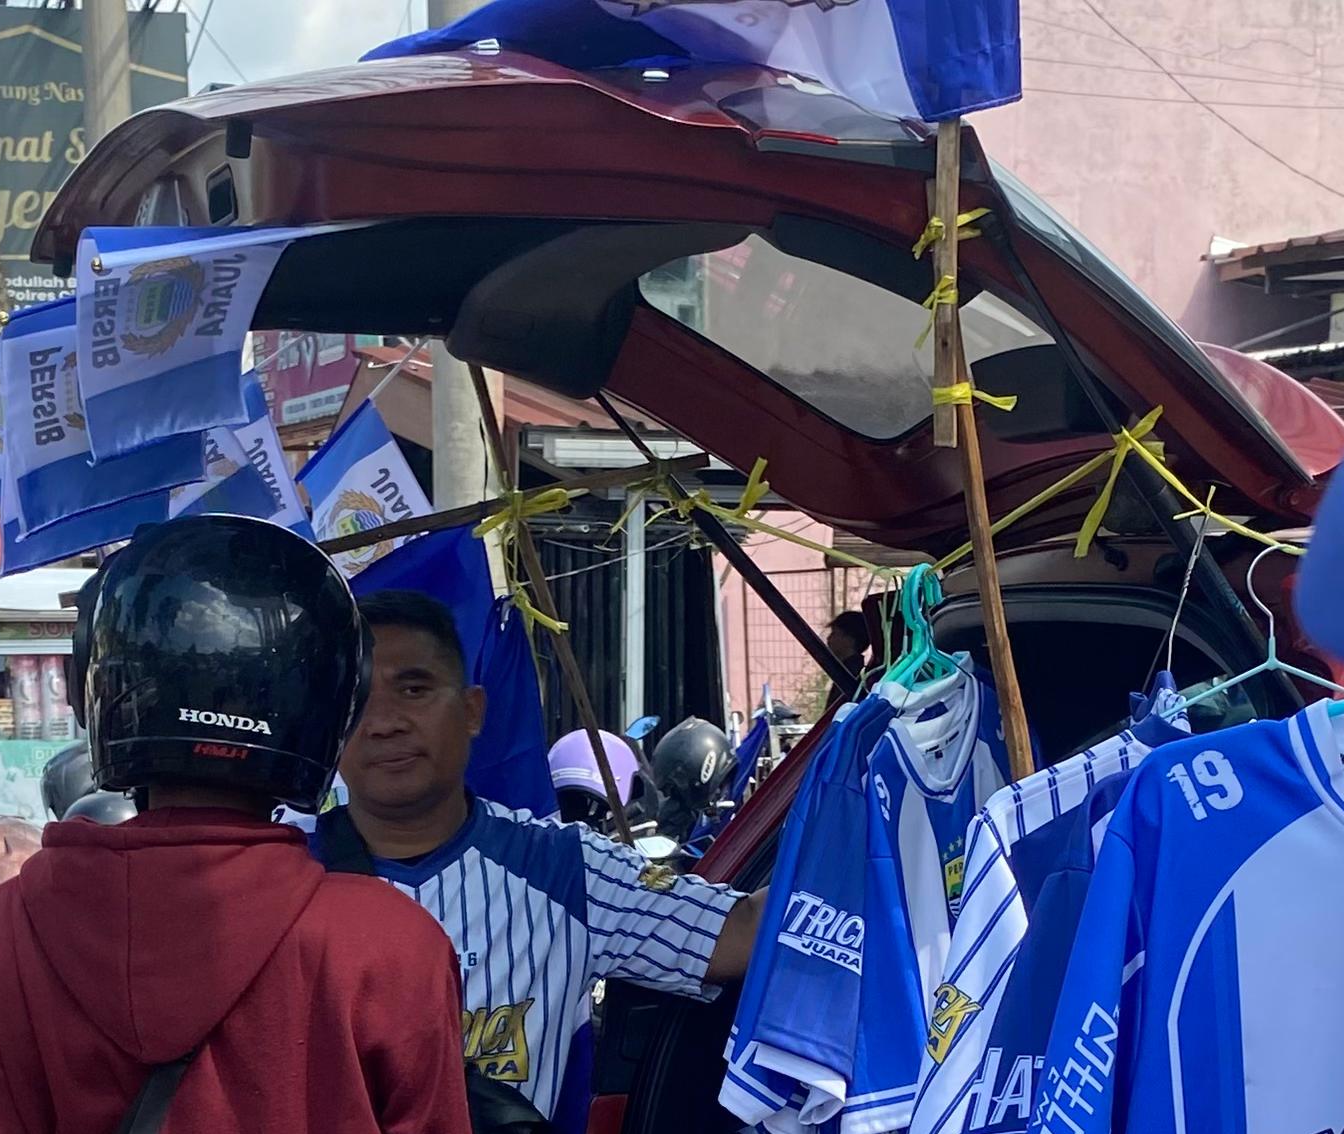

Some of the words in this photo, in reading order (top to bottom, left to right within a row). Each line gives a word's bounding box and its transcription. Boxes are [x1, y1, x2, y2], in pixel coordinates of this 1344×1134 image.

[178, 708, 272, 735] HONDA
[1165, 749, 1244, 821] 19
[801, 940, 860, 969] JUARA
